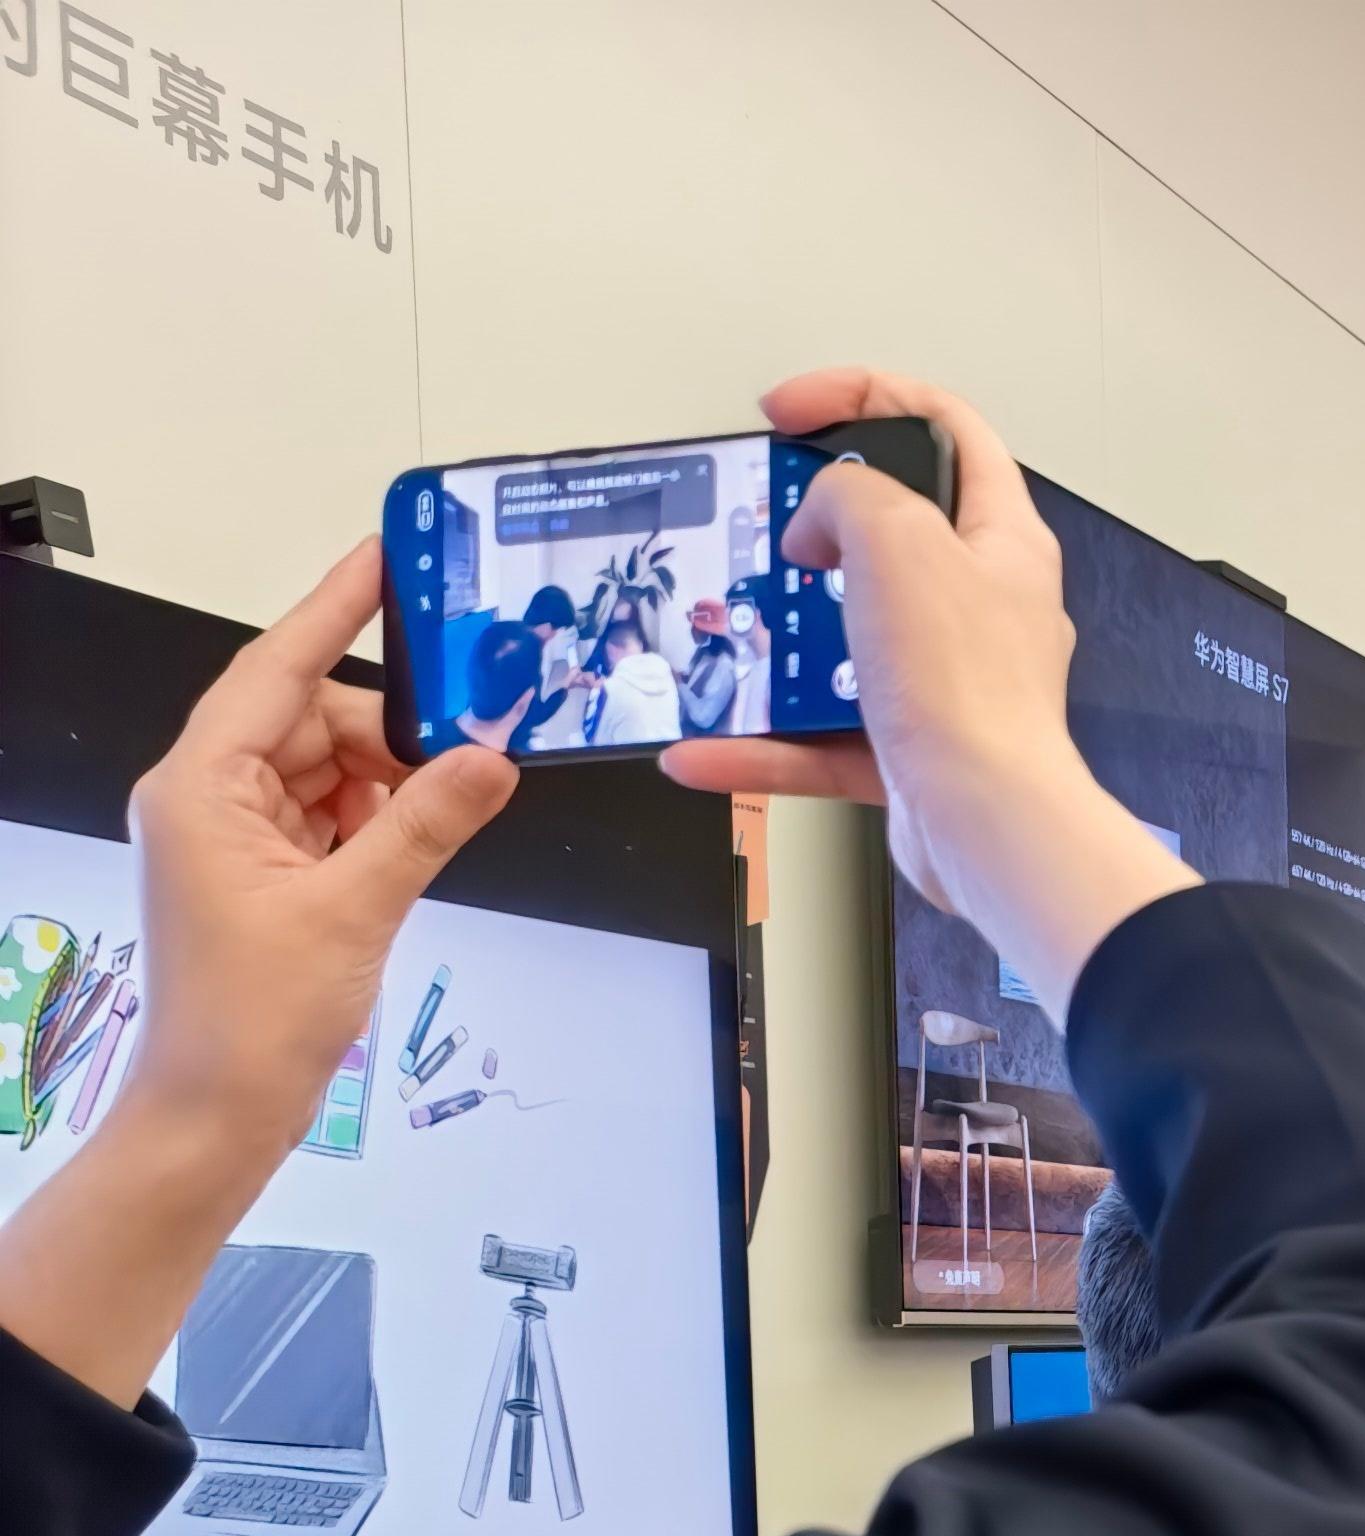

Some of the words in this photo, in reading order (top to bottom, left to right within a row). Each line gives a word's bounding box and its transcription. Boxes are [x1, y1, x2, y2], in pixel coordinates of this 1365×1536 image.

[1195, 630, 1269, 697] 华为智慧屏
[1273, 673, 1289, 704] S7
